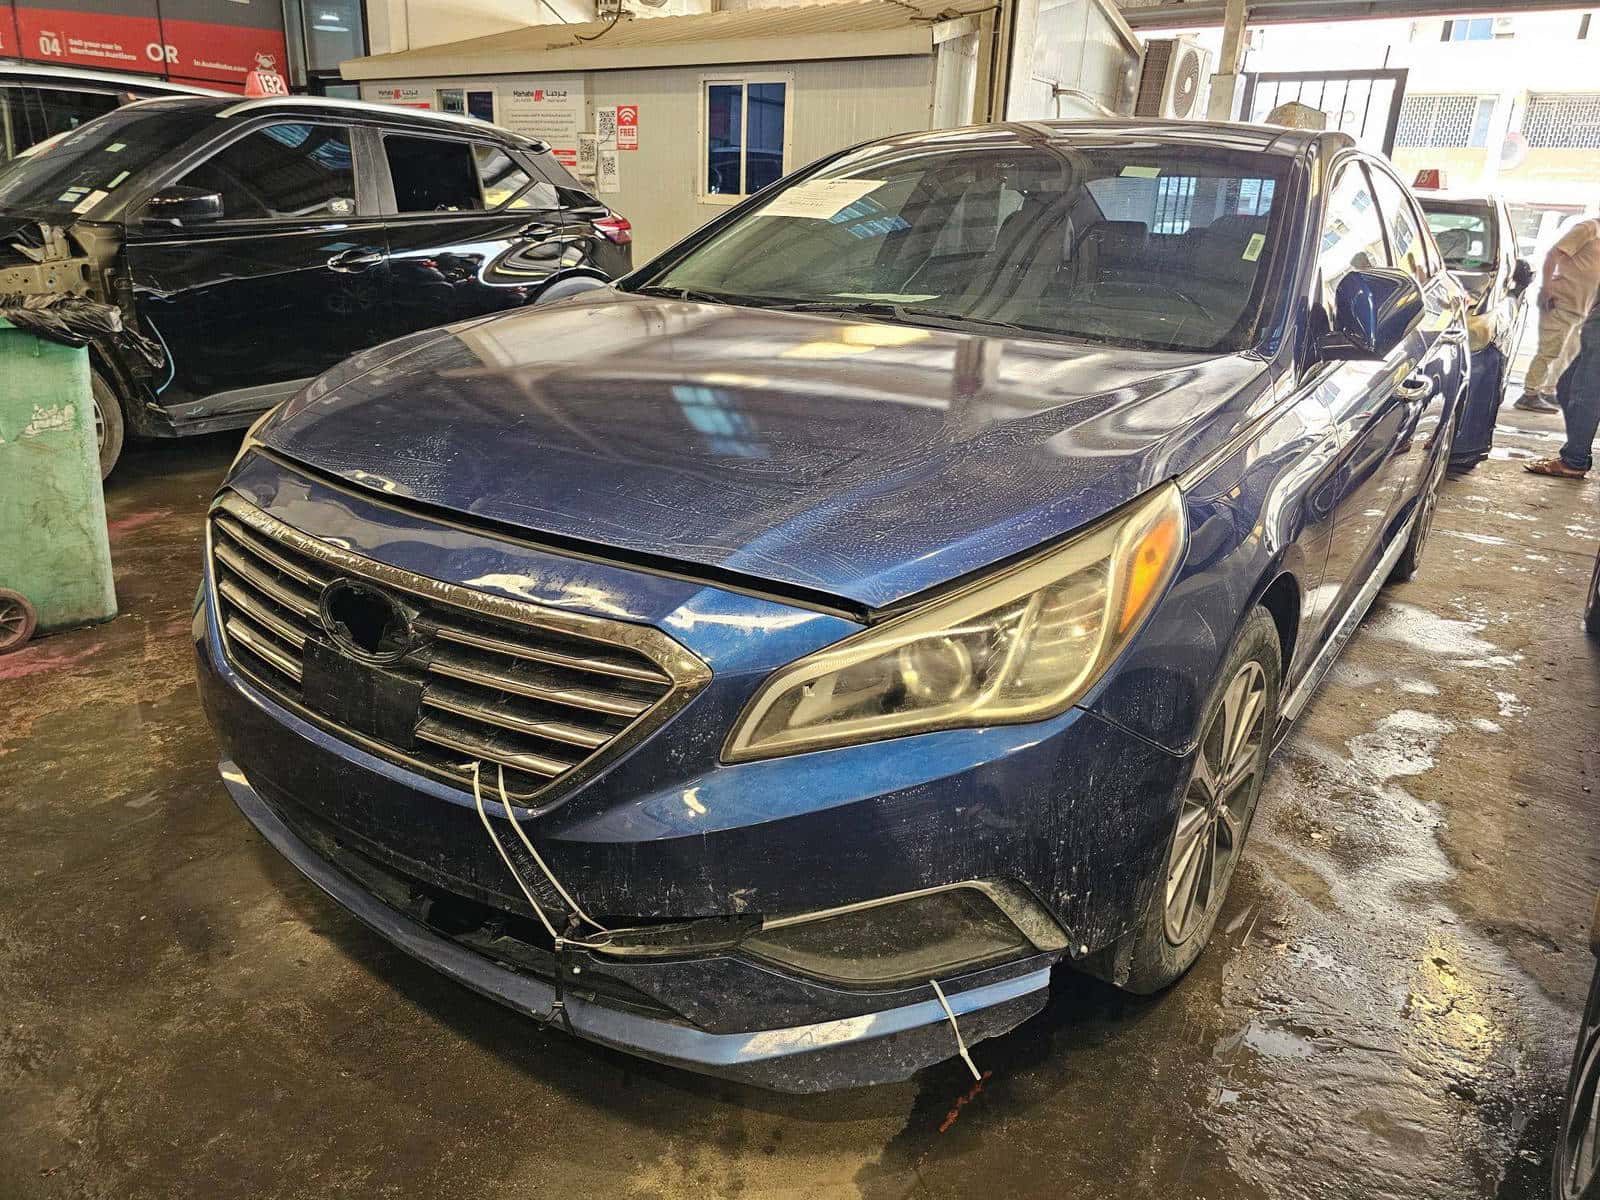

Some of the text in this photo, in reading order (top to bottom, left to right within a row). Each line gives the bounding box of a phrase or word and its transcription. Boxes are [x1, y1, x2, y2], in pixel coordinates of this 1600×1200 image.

[39, 37, 62, 56] 04
[145, 42, 179, 64] OR
[259, 74, 283, 95] 132
[619, 127, 635, 137] FREE
